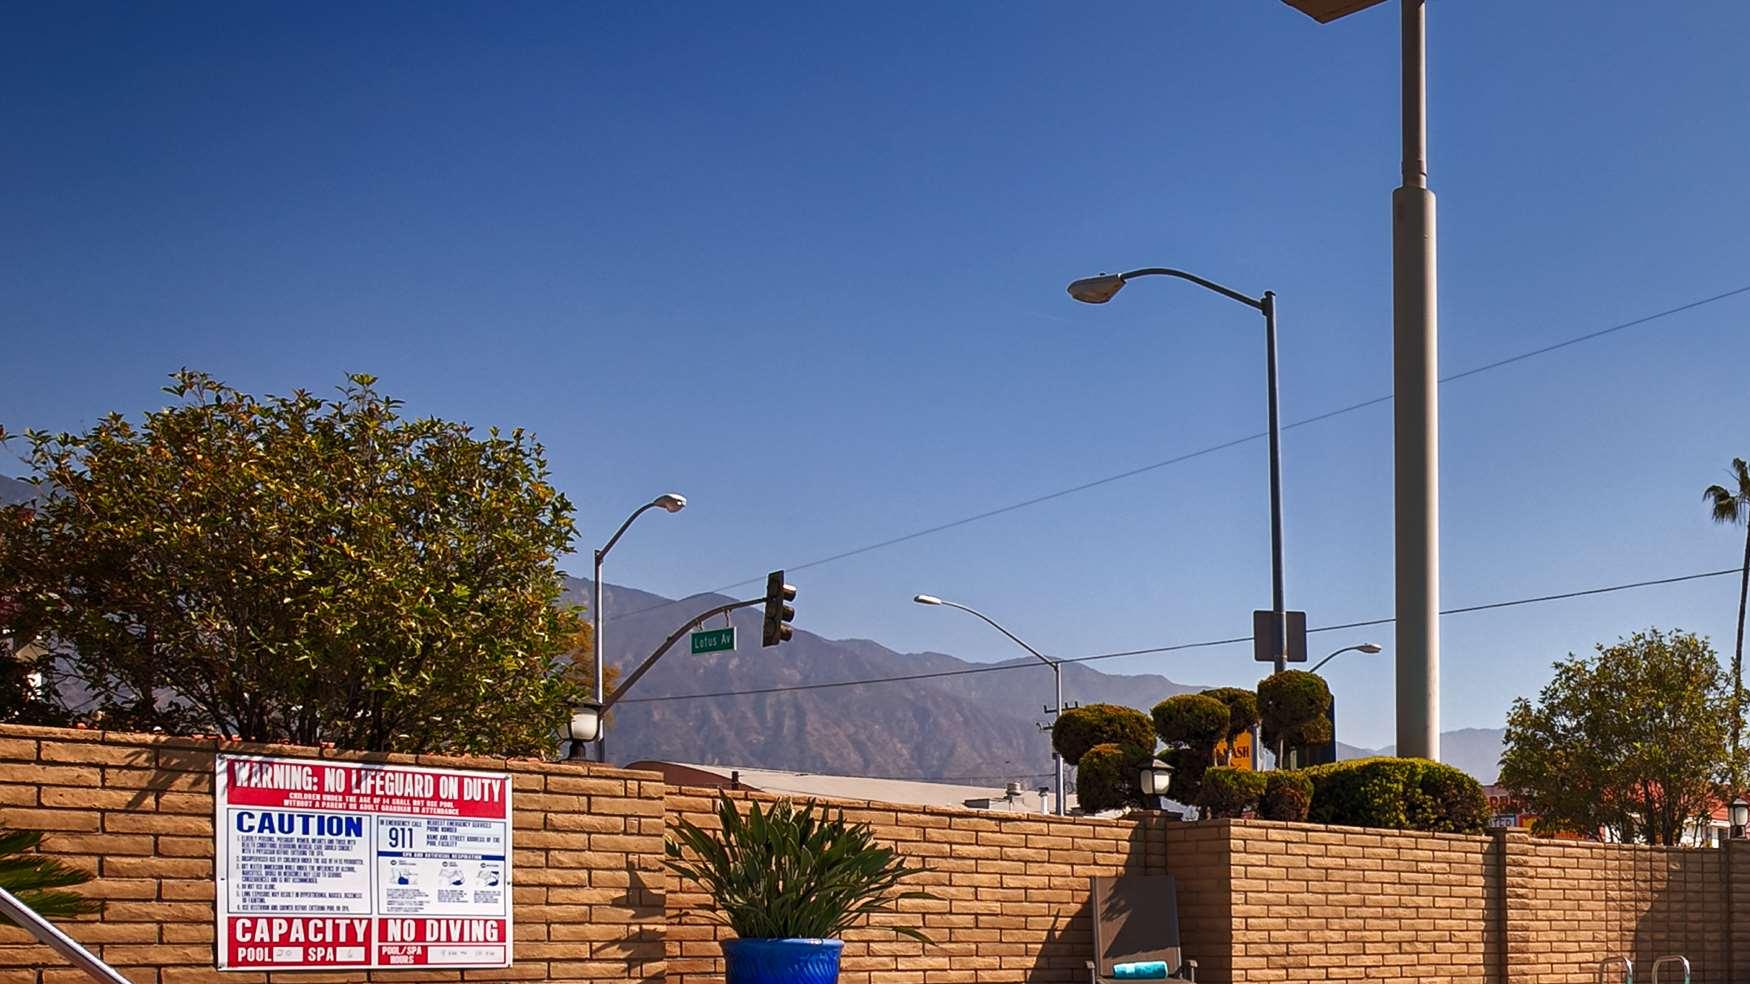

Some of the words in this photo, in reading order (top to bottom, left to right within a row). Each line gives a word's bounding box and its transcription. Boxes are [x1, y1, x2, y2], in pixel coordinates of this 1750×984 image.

[694, 637, 717, 649] Lotus
[720, 635, 731, 644] Av
[234, 762, 319, 791] WARNING:
[324, 767, 346, 793] NO
[351, 769, 434, 798] LIFEGUARD
[439, 775, 459, 800] ON
[463, 778, 501, 802] DUTY
[284, 799, 313, 807] WITHOUT
[321, 801, 347, 809] PARENT
[289, 792, 321, 801] CHILDREN
[236, 811, 363, 837] CAUTION
[388, 827, 413, 848] 911
[235, 918, 368, 943] CAPACITY
[387, 919, 416, 942] NO
[425, 919, 498, 942] DIVING
[237, 947, 272, 962] POOL
[307, 947, 334, 962] SPA
[381, 945, 422, 956] POOL/SPA
